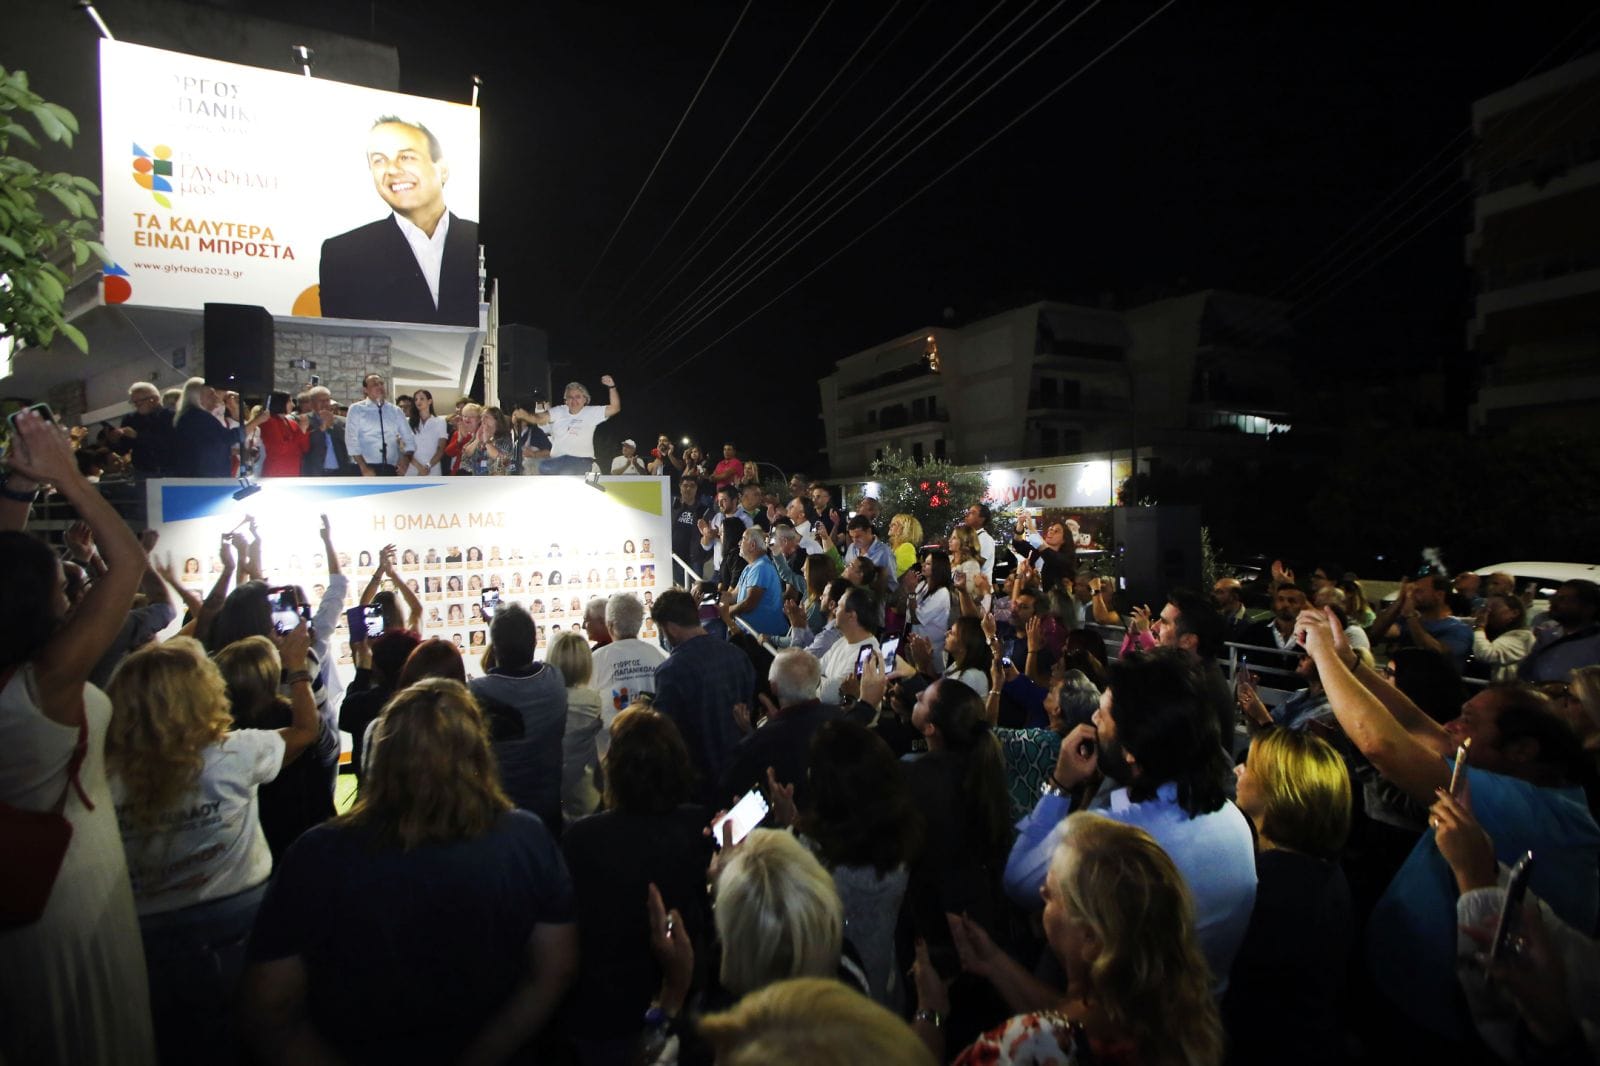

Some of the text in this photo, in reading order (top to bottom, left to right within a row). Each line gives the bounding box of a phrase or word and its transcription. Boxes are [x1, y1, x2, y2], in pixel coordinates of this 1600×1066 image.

[133, 212, 274, 241] ΤΑ ΚΑΛΥΤΕΡΑ
[134, 231, 295, 260] ΕΙΝΑΙ ΜΠΡΟΣΤΑ
[134, 261, 244, 279] www.glyfada2023.gr
[373, 511, 505, 530] Η ΟΜΑΔΑ ΜΑΣ
